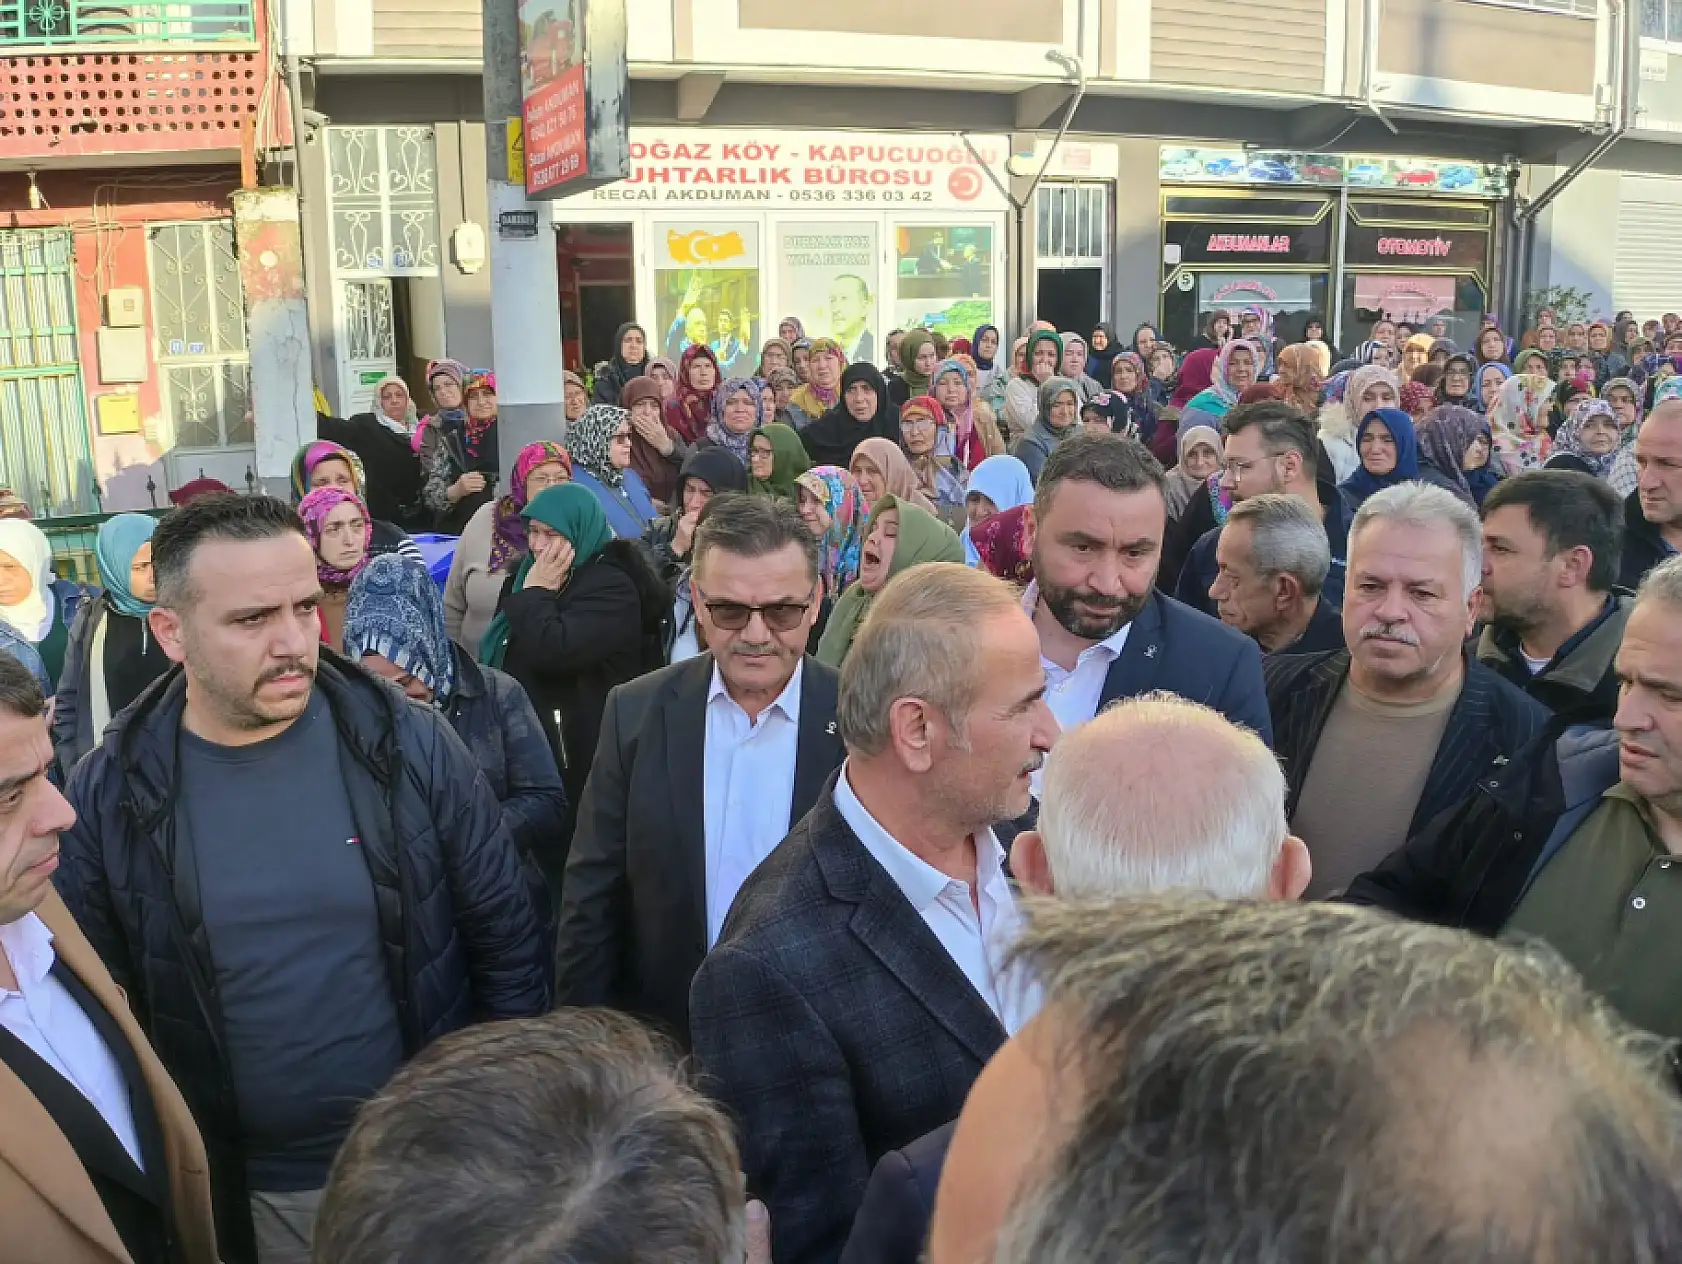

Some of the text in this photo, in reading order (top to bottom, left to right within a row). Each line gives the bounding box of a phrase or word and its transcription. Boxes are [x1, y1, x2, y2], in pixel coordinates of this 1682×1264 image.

[629, 139, 711, 161] OĞAZ
[721, 139, 780, 161] KÖY
[808, 143, 998, 165] KAPUCUOĞLU
[623, 163, 933, 185] UHTARLIK BÜROSU
[592, 186, 657, 201] RECAİ
[664, 189, 771, 200] AKDUMAN
[789, 190, 836, 201] 0536
[842, 190, 876, 201] 336
[882, 190, 904, 201] 03
[909, 191, 933, 201] 42
[1377, 236, 1452, 257] OTOMOTİV
